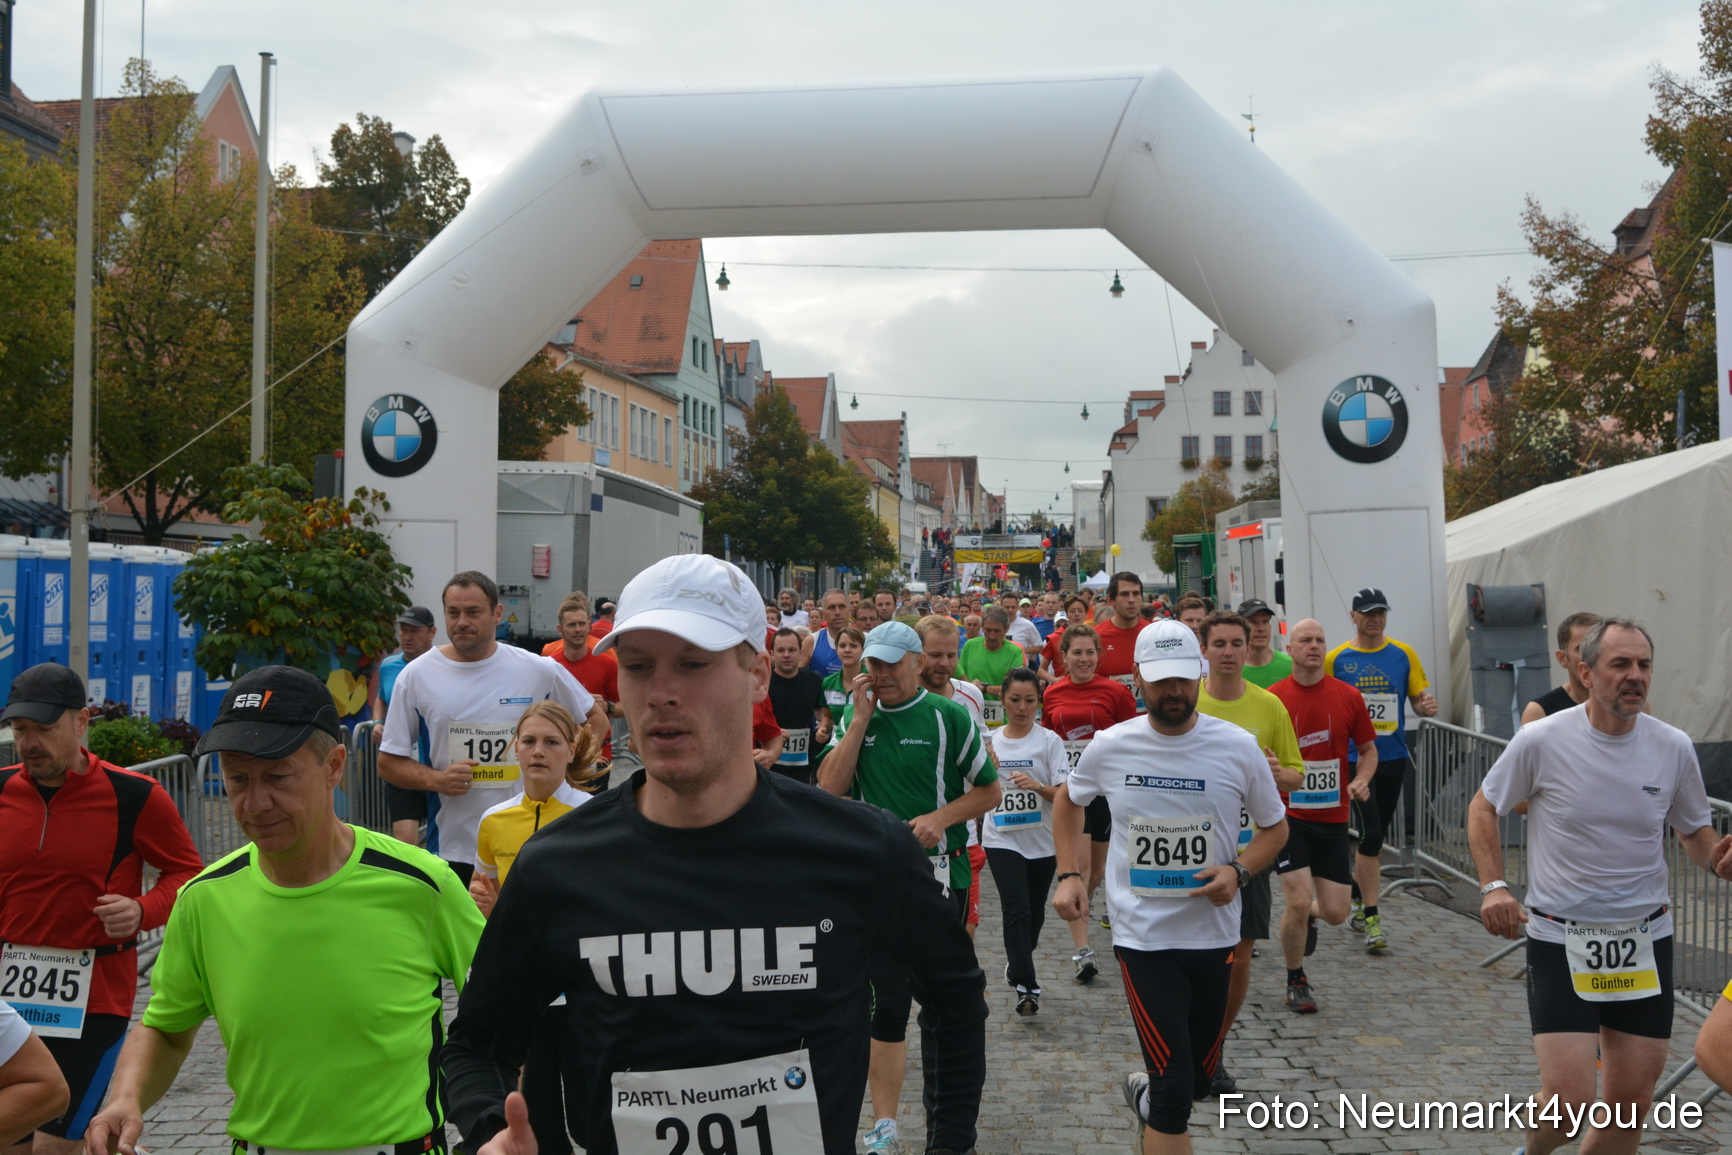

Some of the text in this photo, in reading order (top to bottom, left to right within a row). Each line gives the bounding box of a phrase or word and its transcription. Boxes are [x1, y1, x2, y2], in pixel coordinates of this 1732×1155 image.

[1329, 377, 1401, 407] BMW
[367, 396, 431, 423] BMW
[984, 552, 1014, 560] START
[464, 739, 507, 762] 192
[472, 769, 503, 779] erhard
[1301, 771, 1336, 790] 038
[1147, 778, 1202, 789] BÜSCHEL
[1130, 824, 1199, 833] PARTL Neumarkt
[1136, 835, 1207, 866] 2649
[1158, 874, 1185, 886] Jens
[1567, 926, 1637, 936] PARTL Neumarkt
[3, 952, 75, 964] PARTL Neumarkt
[579, 926, 817, 997] THULE
[1586, 938, 1637, 970] 302
[0, 965, 80, 1002] 2845
[752, 973, 809, 987] SWEDEN
[1591, 977, 1634, 989] Günther
[17, 1008, 60, 1024] atthias
[617, 1077, 778, 1107] PARTL Neumarkt
[655, 1105, 774, 1155] 291
